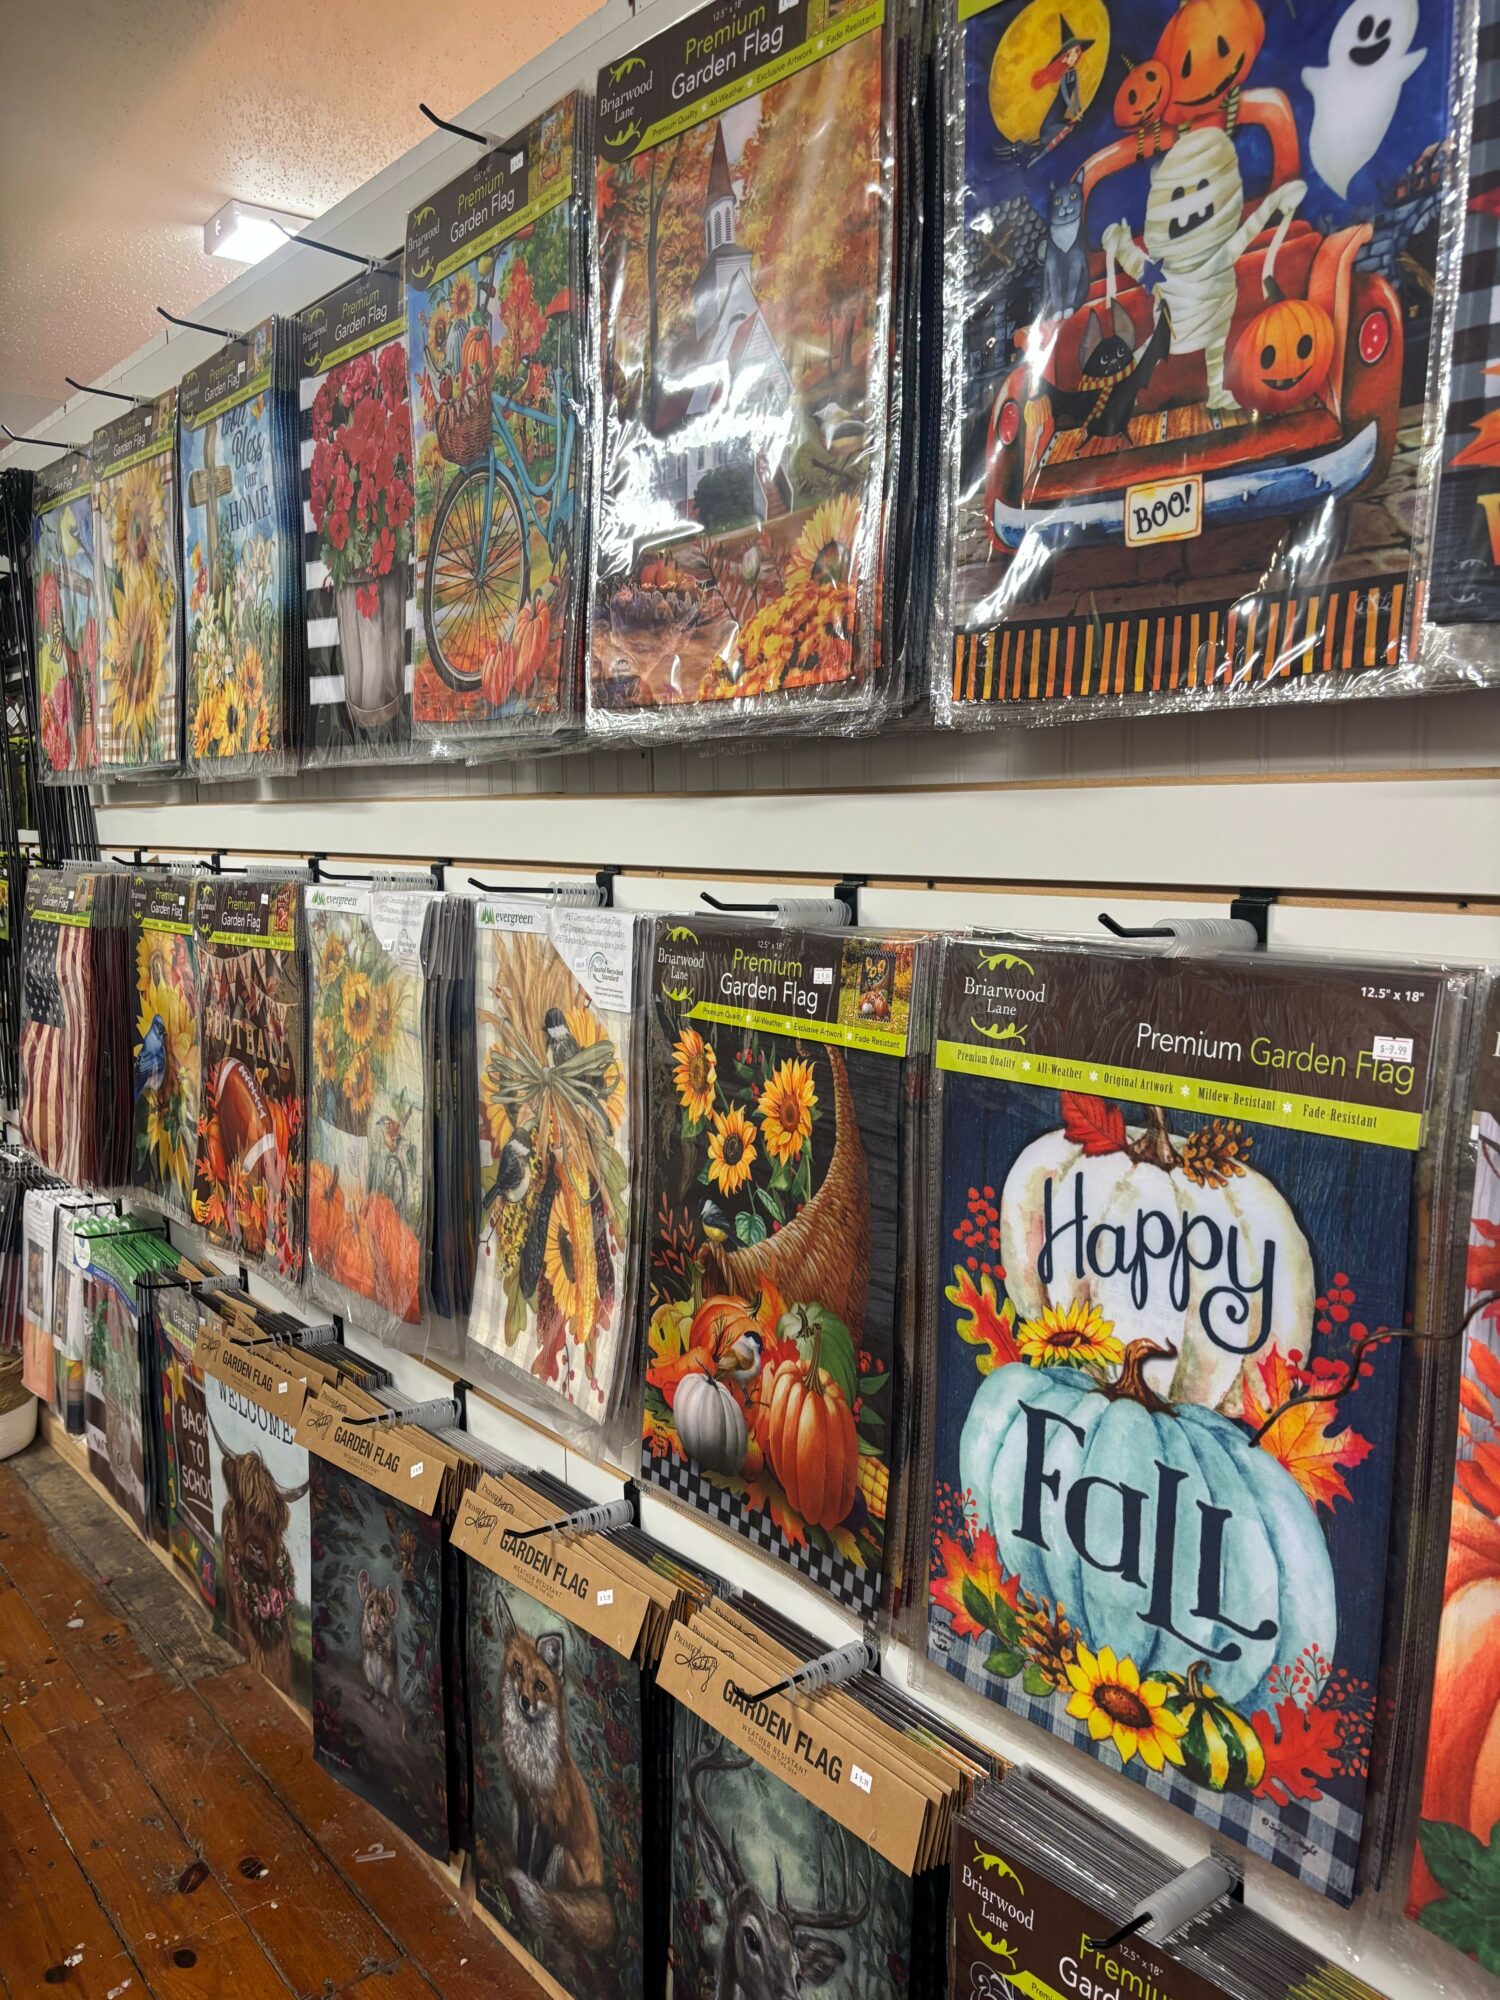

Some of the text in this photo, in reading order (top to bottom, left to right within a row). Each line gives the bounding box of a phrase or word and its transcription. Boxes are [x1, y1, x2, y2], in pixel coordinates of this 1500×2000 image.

[686, 5, 766, 64] Premium
[652, 12, 876, 137] Premium Quality All-Weather Exclusive Artwork Fade Resistant
[671, 25, 783, 99] Garden Flag
[600, 71, 653, 116] Briarwood
[614, 104, 635, 124] Lane
[458, 171, 504, 215] Premium
[450, 188, 515, 243] Garden Flag
[408, 218, 440, 253] Briarwood
[418, 245, 430, 260] Lane
[342, 289, 380, 319] Premium
[334, 304, 387, 342] Garden Flag
[204, 380, 227, 402] Garden
[227, 373, 241, 389] Flag
[113, 438, 133, 457] Garden
[133, 433, 146, 449] Flag
[232, 426, 265, 470] Bless
[228, 485, 271, 531] HOME
[1132, 484, 1192, 535] BOO!
[42, 894, 69, 911] Garden Flag
[150, 901, 183, 921] Garden Flag
[155, 887, 179, 901] Premium
[228, 897, 256, 911] Premium
[326, 894, 358, 907] evergreen
[221, 912, 261, 932] Garden Flag
[495, 911, 534, 925] evergreen
[658, 947, 705, 968] Briarwood
[671, 966, 688, 980] Lane
[733, 948, 803, 978] Premium
[720, 972, 818, 1014] Garden Flag
[964, 977, 1046, 1003] Briarwood
[986, 999, 1017, 1016] Lane
[1361, 986, 1425, 1002] 12.5" x 18"
[752, 1015, 783, 1028] All-Weather
[793, 1021, 819, 1035] Exclusive
[820, 1026, 843, 1039] Artwork
[854, 1032, 870, 1043] Fade
[870, 1036, 900, 1049] Resistant
[1137, 1022, 1415, 1095] Premium Garden Flag
[957, 1049, 1377, 1129] Premium Quality All-Weather Original Artwork Mildew-Resistant Fade-Resistant
[1037, 1171, 1275, 1354] Happy
[222, 1349, 252, 1380] GARDEN
[252, 1367, 273, 1393] FLAG
[181, 1404, 209, 1438] BACK
[218, 1381, 294, 1446] WELCOME
[189, 1439, 205, 1468] TO
[334, 1426, 374, 1460] GARDEN
[373, 1446, 401, 1474] FLAG
[182, 1464, 213, 1500] SCHOO
[500, 1533, 590, 1600] GARDEN FLAG
[722, 1679, 843, 1784] GARDEN FLAG
[742, 1723, 808, 1776] WEATHER RESISTANT
[961, 1865, 1035, 1931] Briarwood
[981, 1902, 1009, 1932] Lane
[1059, 1955, 1121, 2000] Gar
[1079, 1932, 1173, 2000] Premiu
[1119, 1944, 1140, 1961] 12.5"
[1149, 1963, 1164, 1977] 18"
